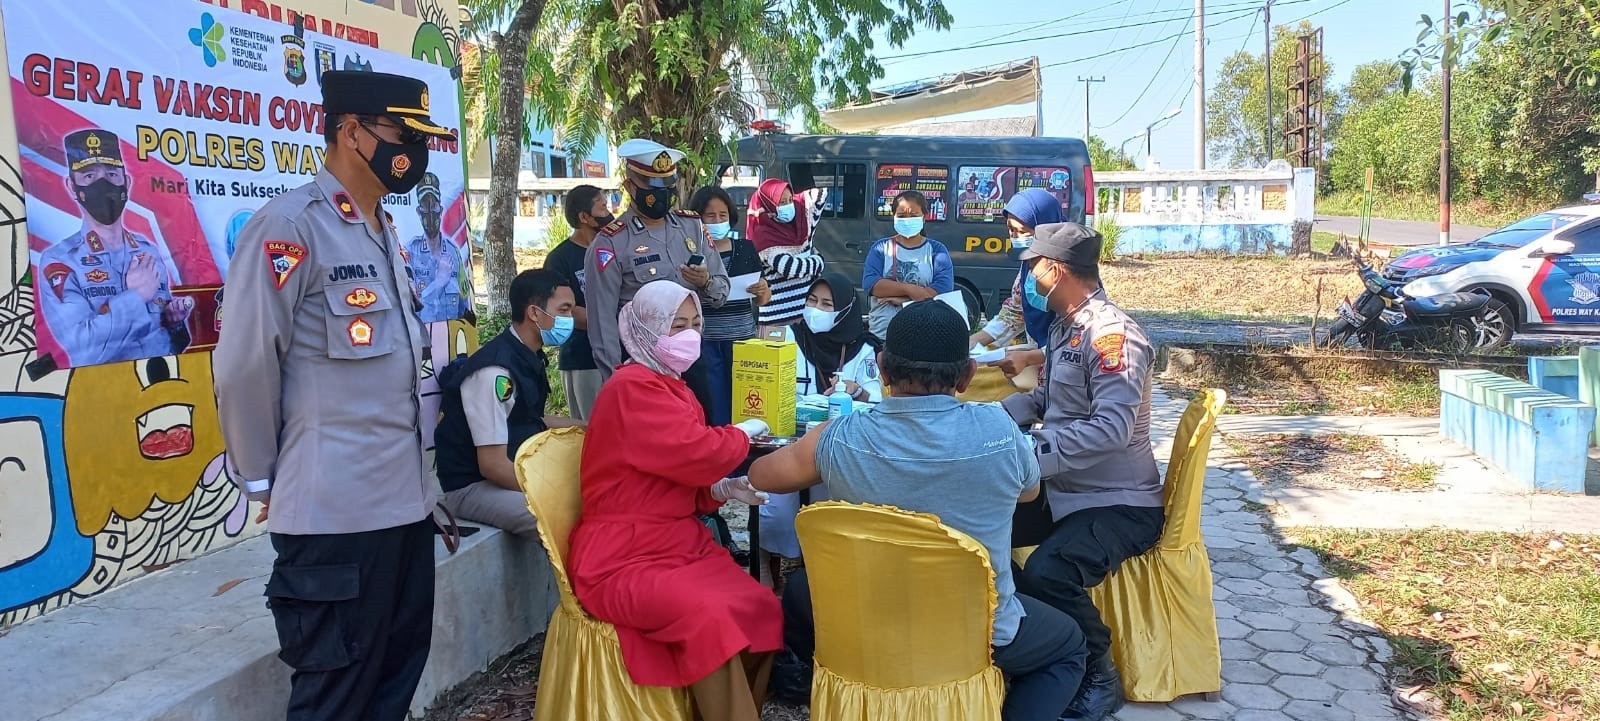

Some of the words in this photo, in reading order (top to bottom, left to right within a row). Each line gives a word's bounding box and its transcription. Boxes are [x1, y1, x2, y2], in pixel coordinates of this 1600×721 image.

[229, 25, 275, 45] KEMENTERIAN
[230, 36, 268, 53] KESEHATAN
[231, 46, 263, 62] REPUBLIK
[232, 57, 268, 73] INDONESIA
[22, 53, 143, 110] GERAI
[153, 75, 261, 126] VAKSIN
[269, 96, 325, 135] COVI
[136, 125, 265, 172] POLRES
[151, 175, 189, 194] Mari
[195, 179, 226, 196] Kita
[231, 182, 294, 199] Suksesk
[382, 193, 411, 206] sional
[269, 243, 286, 251] BAG
[288, 246, 303, 256] OPS
[1551, 308, 1577, 316] POLRES
[1578, 308, 1593, 316] WAY
[1060, 350, 1081, 363] POLRI
